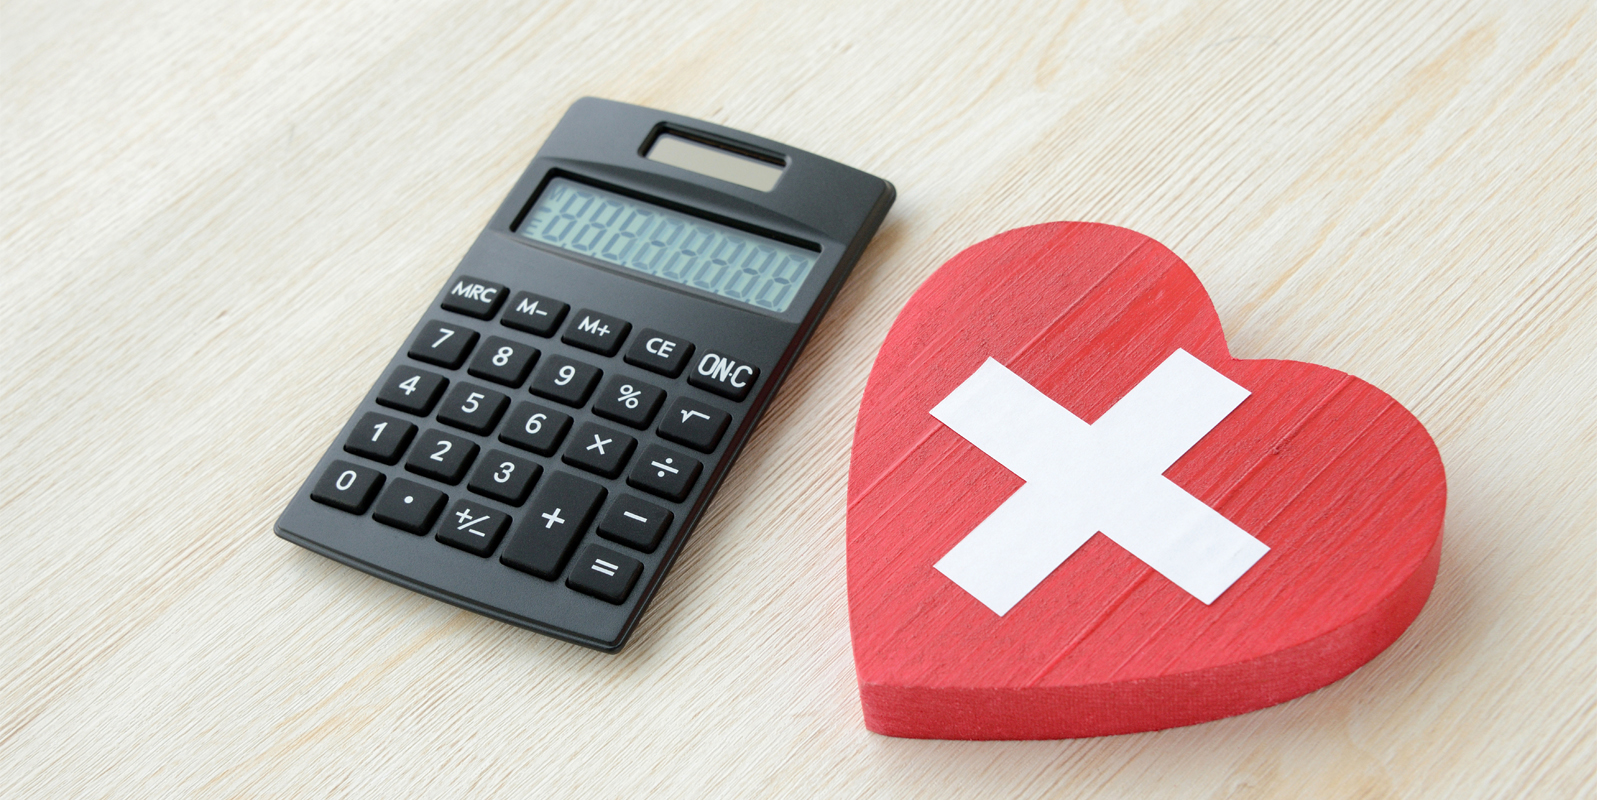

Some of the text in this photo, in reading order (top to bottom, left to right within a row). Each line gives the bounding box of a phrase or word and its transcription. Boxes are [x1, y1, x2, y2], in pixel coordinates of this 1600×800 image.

[451, 281, 497, 304] MRC
[577, 315, 611, 337] M+
[432, 328, 455, 349] 7
[645, 337, 677, 359] CE
[491, 346, 514, 367] 8
[398, 375, 422, 396] 4
[554, 365, 576, 386] 9
[461, 391, 485, 414] 5
[617, 384, 642, 409] %
[371, 421, 389, 442] 1
[525, 412, 548, 434] 6
[429, 440, 453, 462] 2
[335, 469, 358, 491] 0
[493, 461, 516, 483] 3
